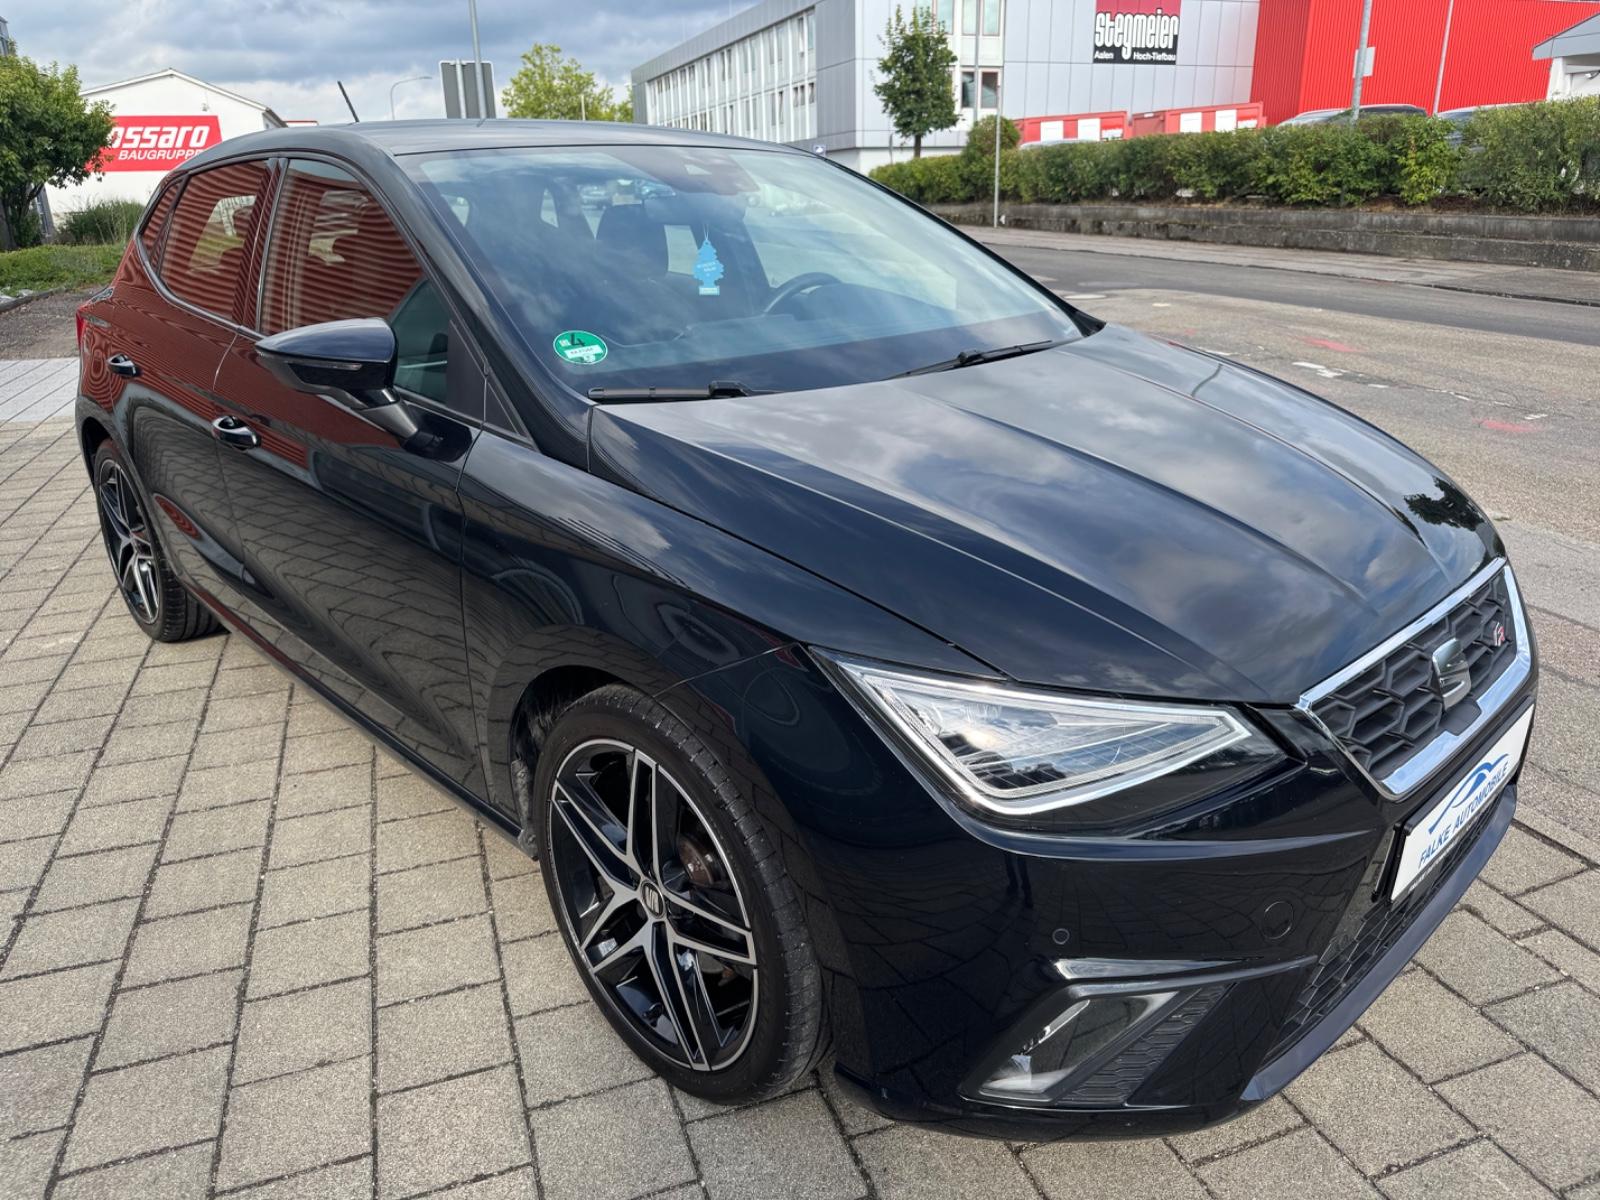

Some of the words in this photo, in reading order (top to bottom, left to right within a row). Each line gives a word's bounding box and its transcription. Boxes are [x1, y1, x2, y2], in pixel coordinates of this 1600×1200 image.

[1094, 51, 1114, 59] Aalen
[107, 126, 210, 149] ossaro
[1418, 825, 1452, 870] FALKE
[1452, 761, 1509, 833] AUTOMOBILE
